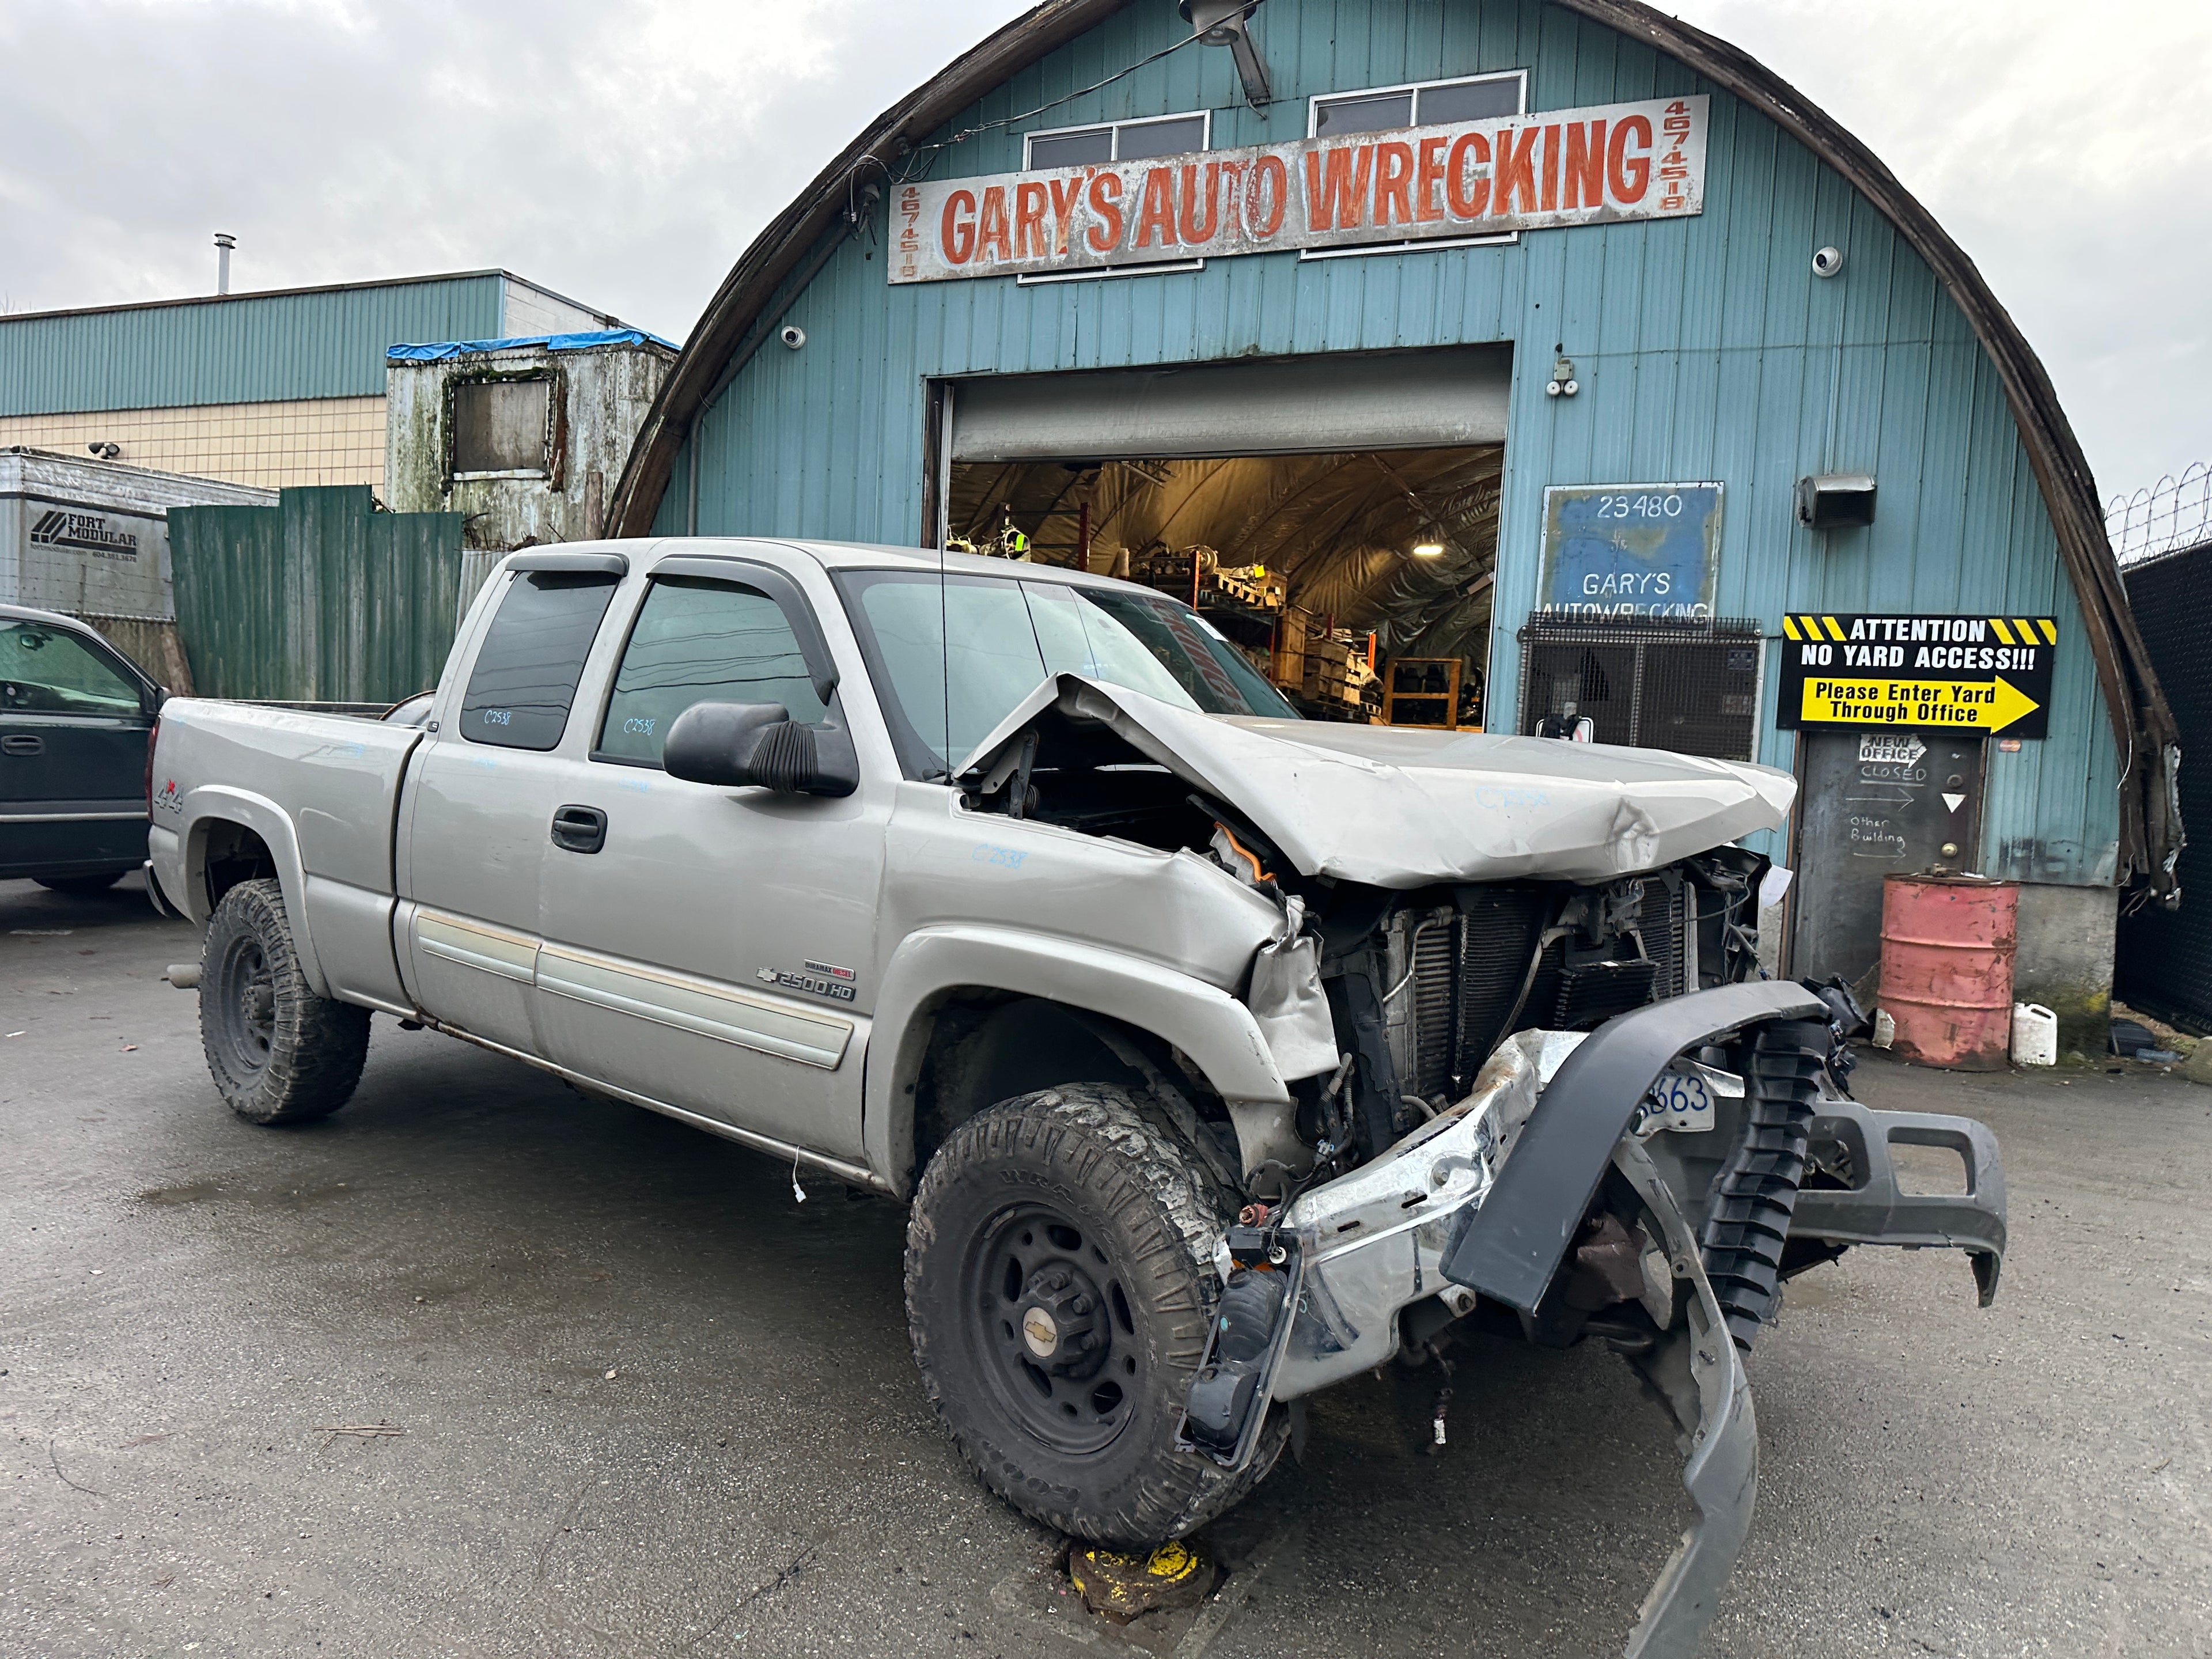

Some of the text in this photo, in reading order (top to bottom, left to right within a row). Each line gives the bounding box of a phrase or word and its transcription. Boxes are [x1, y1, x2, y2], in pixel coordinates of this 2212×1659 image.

[940, 114, 1653, 265] GARY'S AUTO WRECKING
[1597, 494, 1683, 518] 23480
[68, 513, 105, 529] FORT
[67, 525, 137, 546] MODULAR
[1583, 573, 1671, 594] GARY'S
[1850, 618, 1986, 642] ATTENTION
[1801, 644, 2036, 671] NO YARD ACCESS!!!
[1815, 681, 1996, 704] Please Enter Yard
[1830, 700, 1978, 722] Through Office
[484, 710, 656, 736] C2538 C2538
[1872, 736, 1910, 747] NEW
[1861, 747, 1918, 760] OFFICE
[1861, 765, 1927, 781] CLOSED
[1850, 816, 1890, 828] Other
[1850, 828, 1905, 849] Building
[805, 961, 852, 978] DURAMAX DIESEL
[779, 971, 853, 999] 2500 HD
